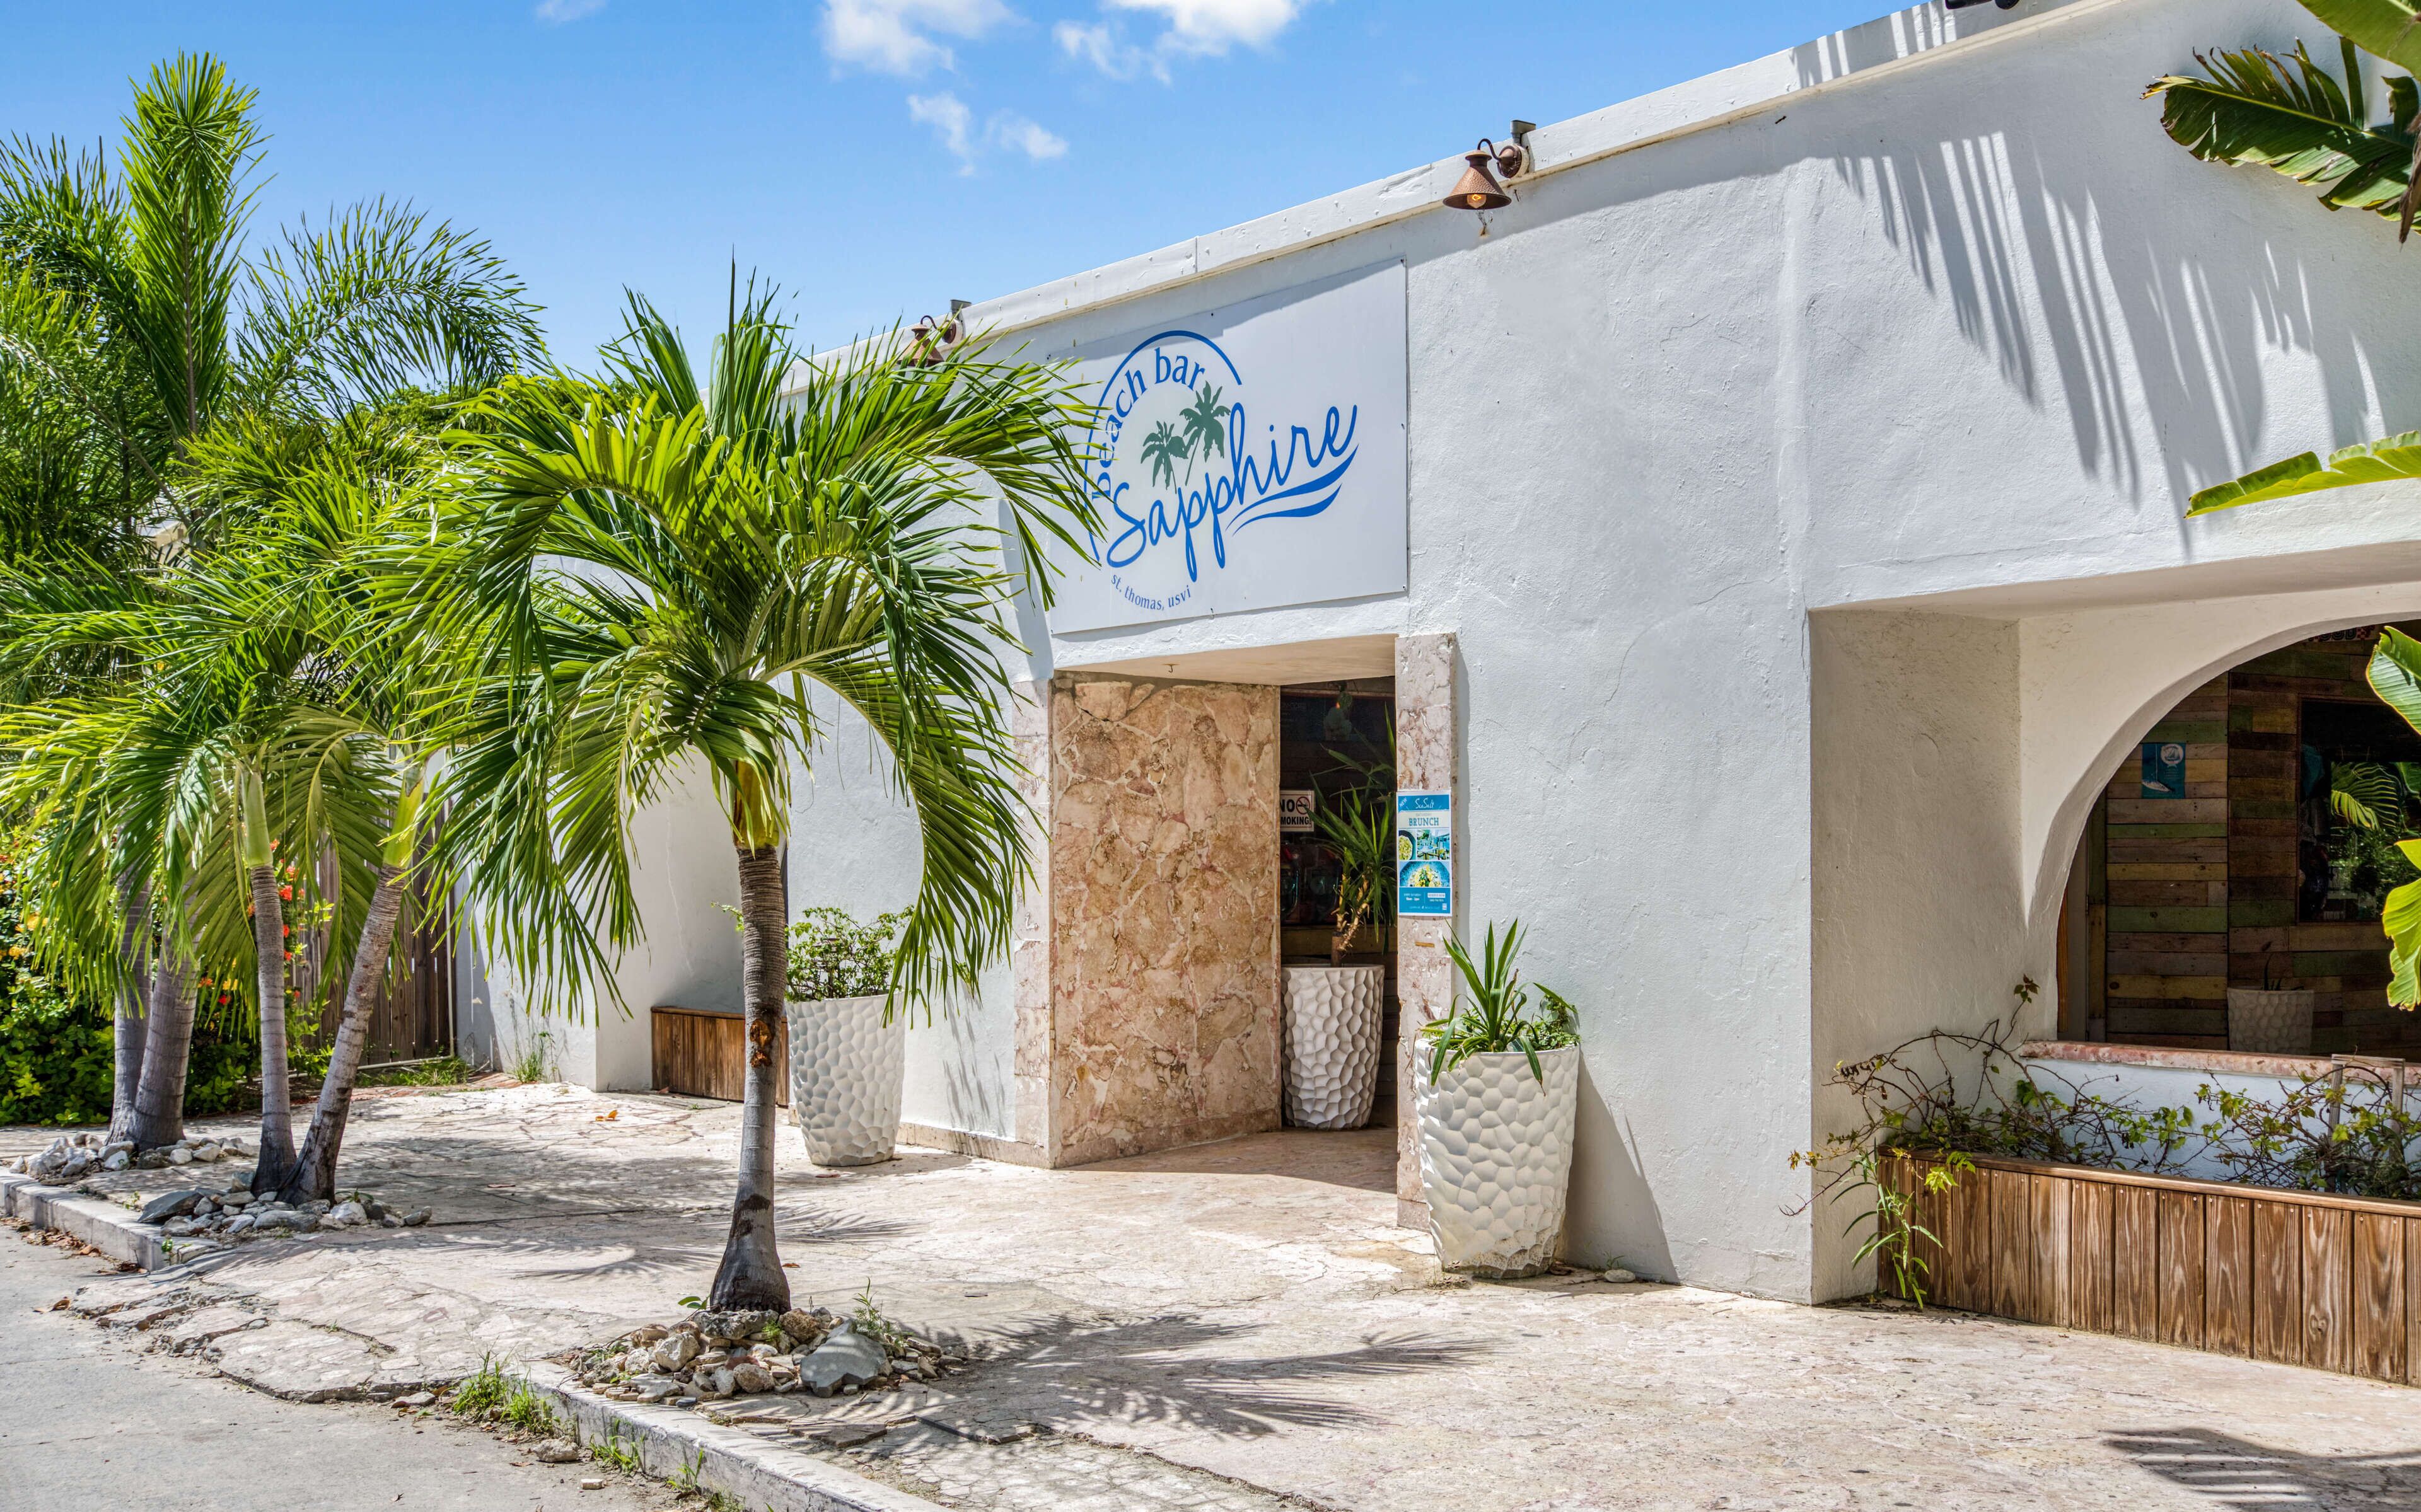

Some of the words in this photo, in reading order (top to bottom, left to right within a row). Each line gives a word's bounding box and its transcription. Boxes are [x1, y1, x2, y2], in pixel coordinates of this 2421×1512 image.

[1091, 369, 1147, 500] beach
[1154, 347, 1205, 390] bar
[1106, 401, 1357, 582] Sapphire
[1111, 574, 1122, 592] st.
[1124, 586, 1164, 611] thomas,
[1168, 584, 1191, 608] usvi
[1280, 816, 1311, 825] MOKING!
[1408, 817, 1439, 826] BRUNCH
